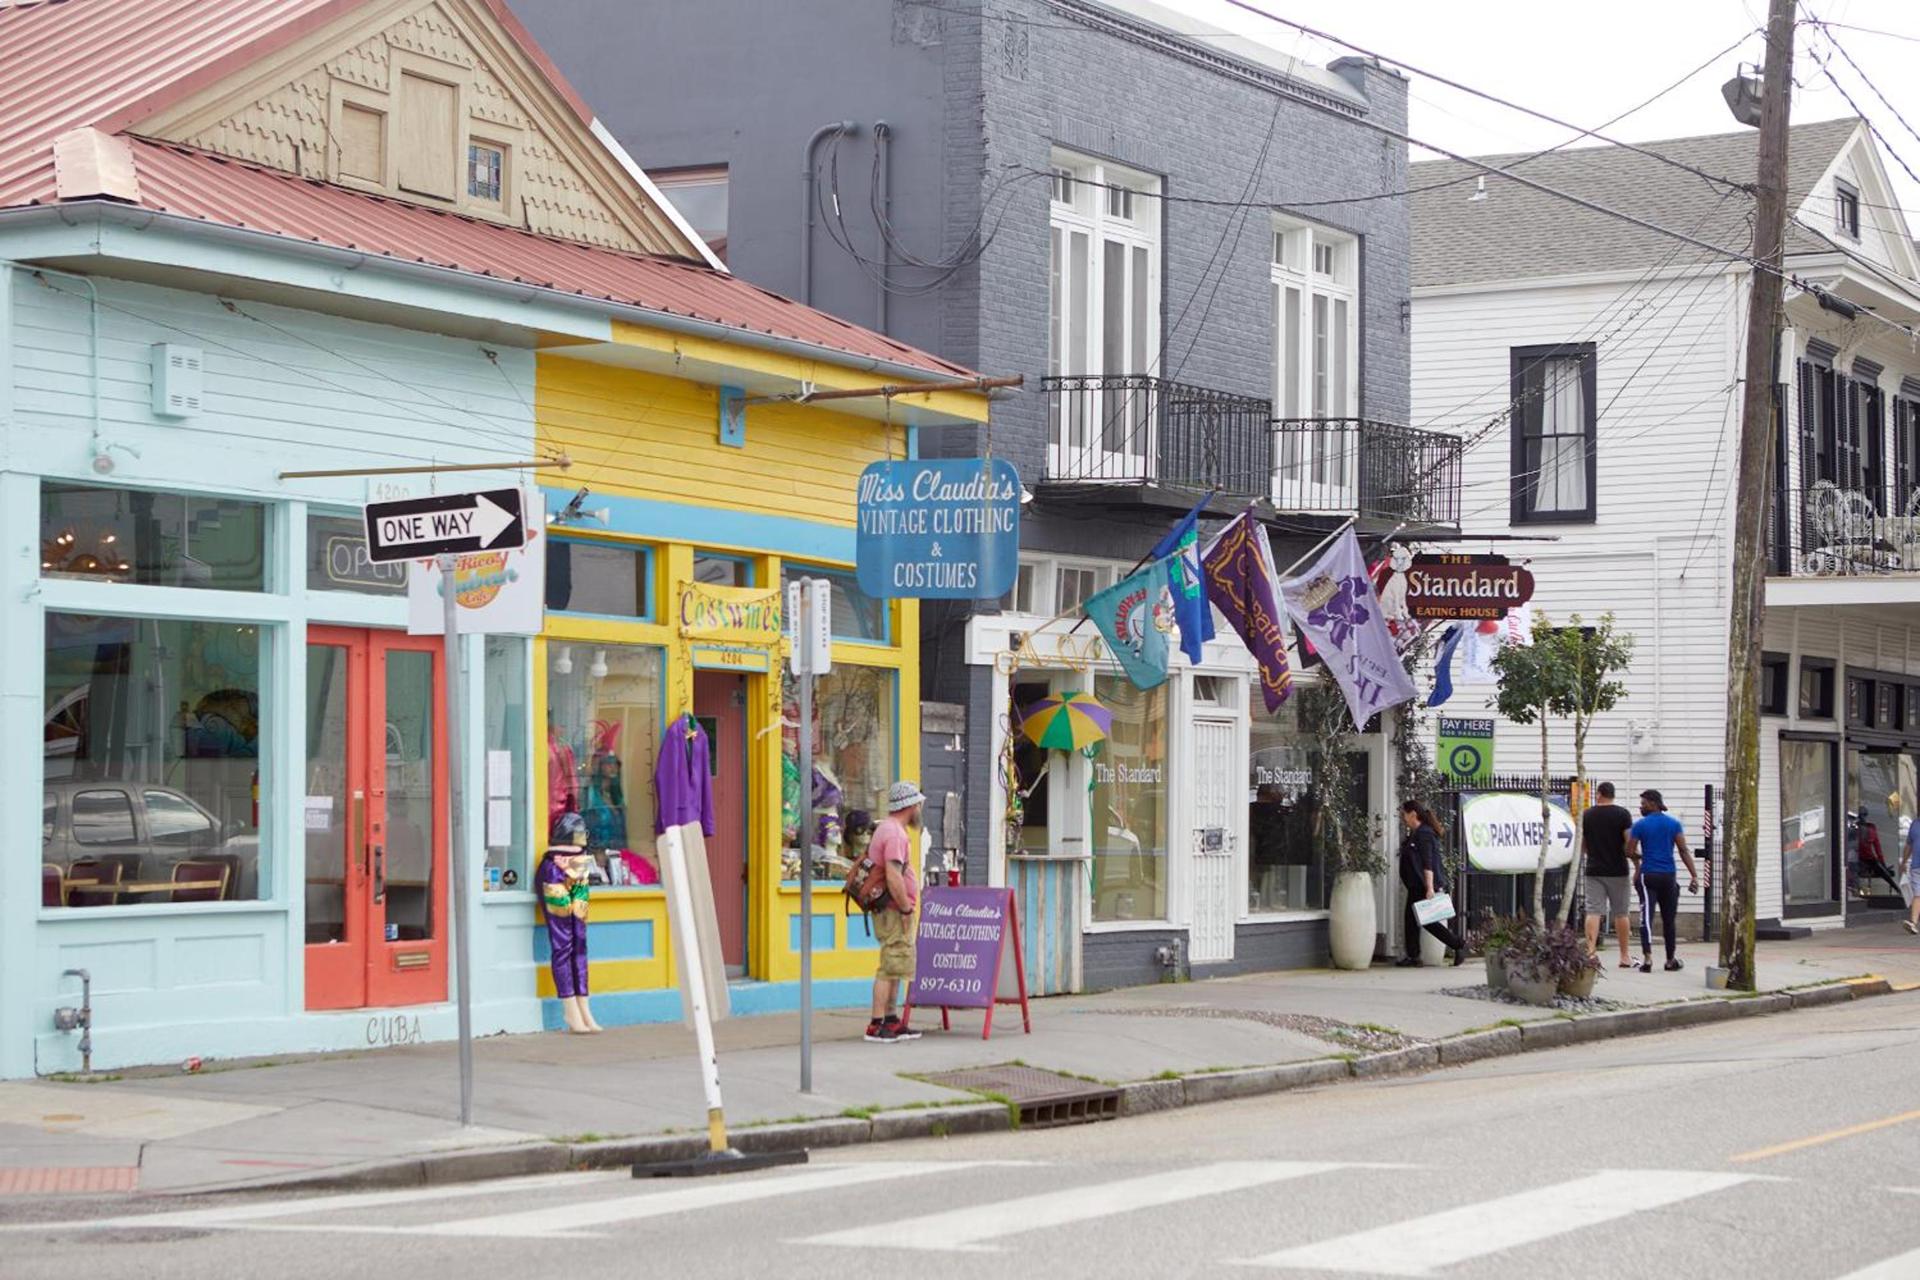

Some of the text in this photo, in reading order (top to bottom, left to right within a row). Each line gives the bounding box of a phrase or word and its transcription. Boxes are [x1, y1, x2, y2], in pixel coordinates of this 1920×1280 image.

[860, 470, 1015, 506] Miss Claudia's
[383, 511, 474, 543] ONE WAY
[860, 507, 1014, 535] VINTAGE CLOTHING
[931, 541, 943, 557] &
[1440, 555, 1472, 564] THE
[893, 563, 977, 589] COSTUMES
[1408, 570, 1520, 597] Standard
[680, 590, 780, 632] Costumes
[1416, 607, 1499, 617] EATING HOUSE
[1442, 718, 1492, 731] PAY HERE
[1096, 763, 1161, 784] The Standard
[1257, 766, 1312, 786] The Standard
[1522, 821, 1552, 846] HER
[926, 902, 952, 917] Miss
[919, 922, 1000, 941] VINTAGE CLOTHING
[933, 953, 977, 969] COSTUMES
[920, 977, 981, 993] 897-6310
[367, 1016, 422, 1044] CUBA
